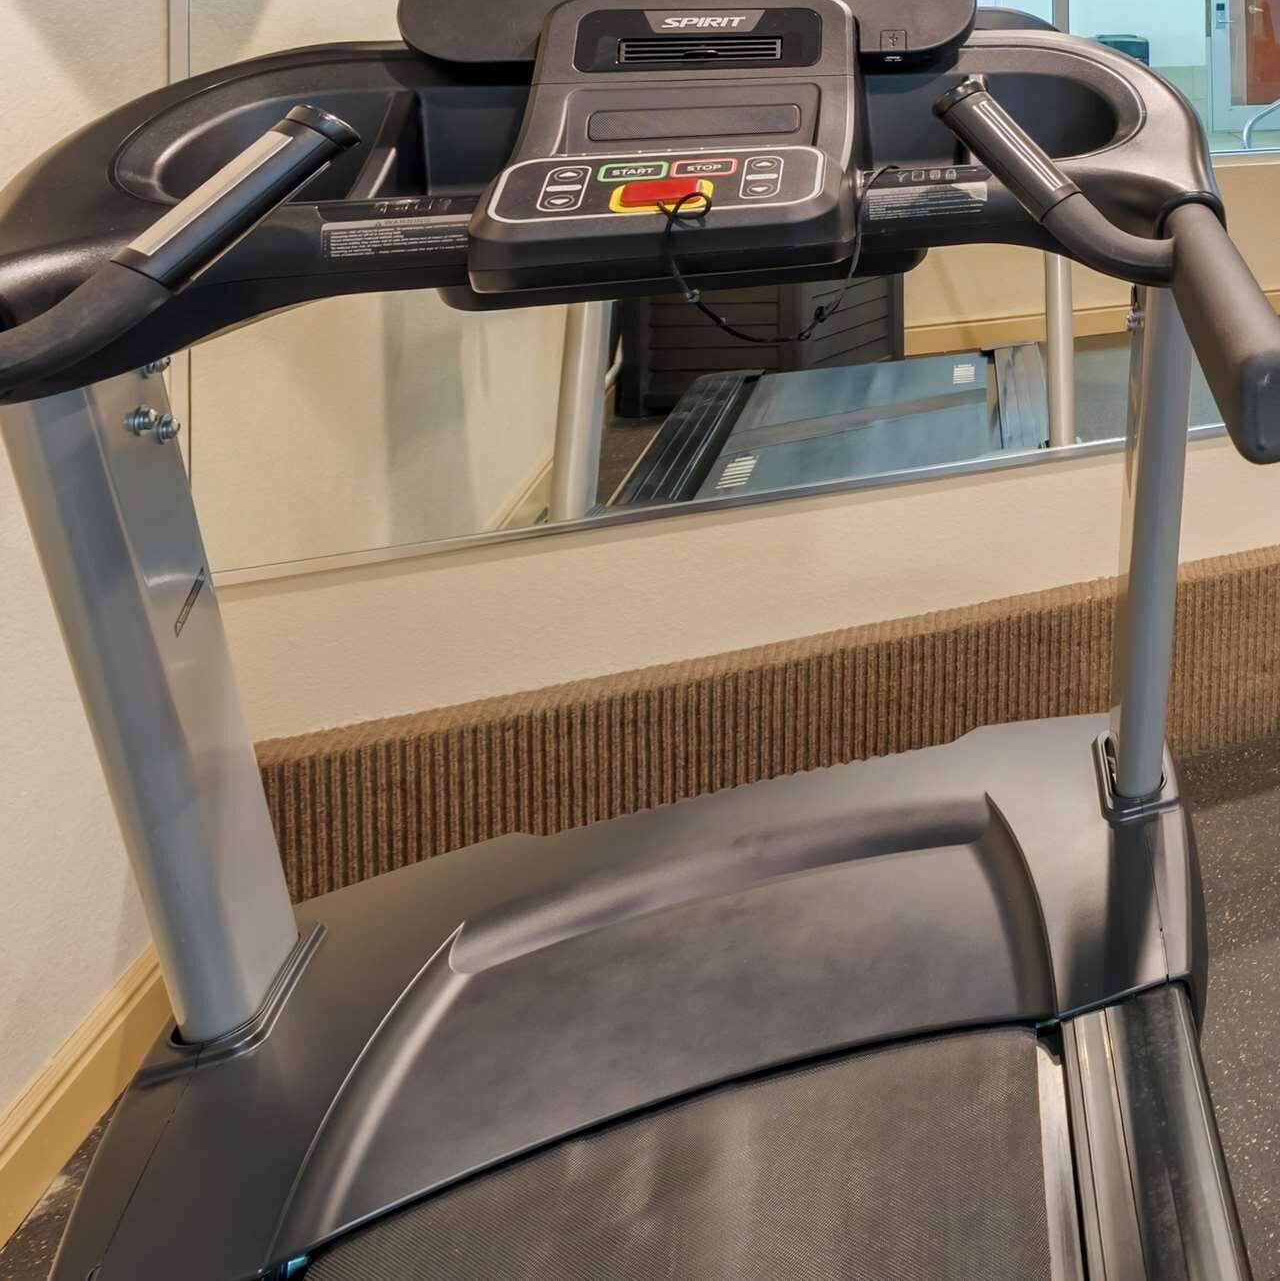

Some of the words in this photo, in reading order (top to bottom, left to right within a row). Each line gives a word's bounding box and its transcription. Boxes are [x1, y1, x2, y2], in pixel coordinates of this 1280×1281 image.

[661, 16, 746, 29] SPIRIT
[611, 167, 655, 177] START
[686, 163, 723, 172] STOP
